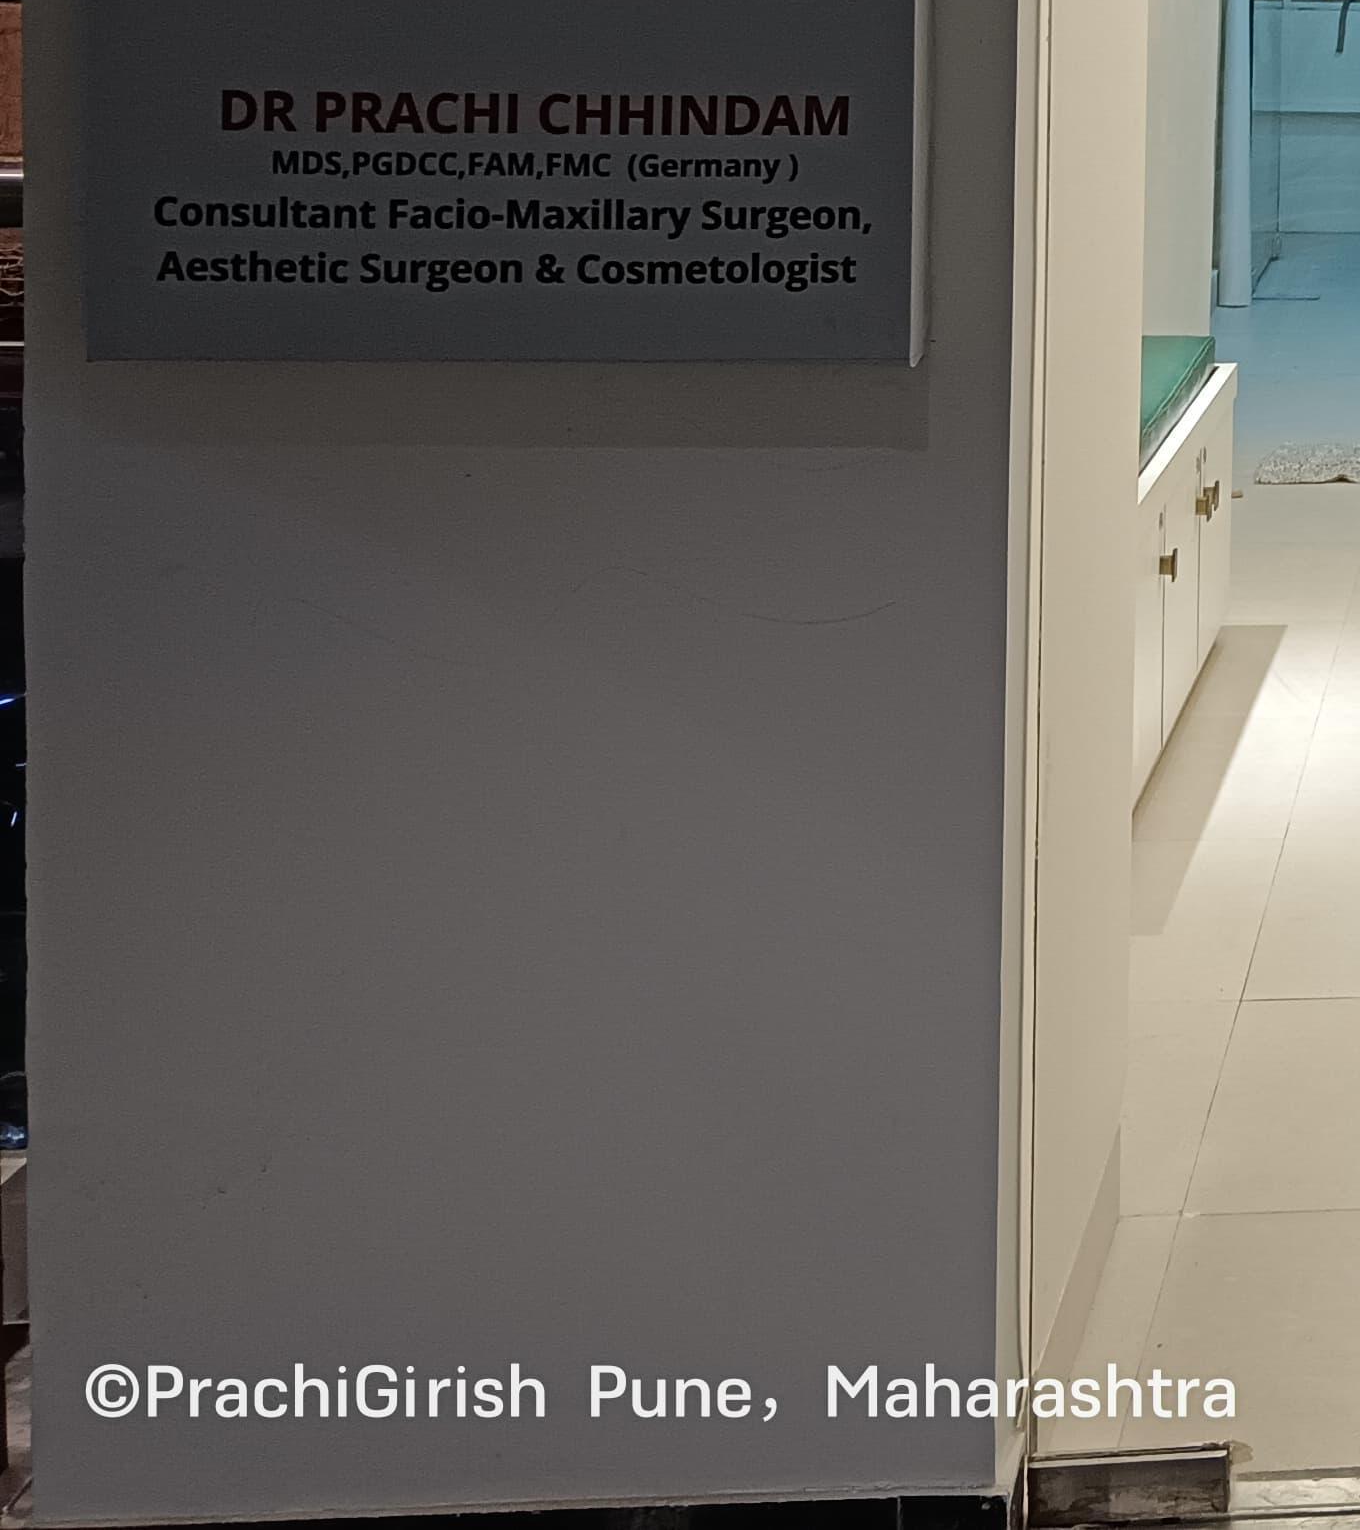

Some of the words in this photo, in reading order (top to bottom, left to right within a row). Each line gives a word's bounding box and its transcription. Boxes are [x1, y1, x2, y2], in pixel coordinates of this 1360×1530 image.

[222, 90, 296, 131] DR
[316, 92, 517, 133] PRACHI
[540, 94, 848, 135] CHHINDAM
[273, 151, 611, 179] MDS,PGDCC,FAM,FMC
[155, 196, 375, 229] Consultant
[389, 198, 690, 239] Facio-Maxillary
[702, 201, 871, 238] Surgeon,
[157, 251, 348, 283] Aesthetic
[360, 254, 522, 292] Surgeon
[536, 254, 564, 283] &
[577, 253, 856, 292] Cosmetologist
